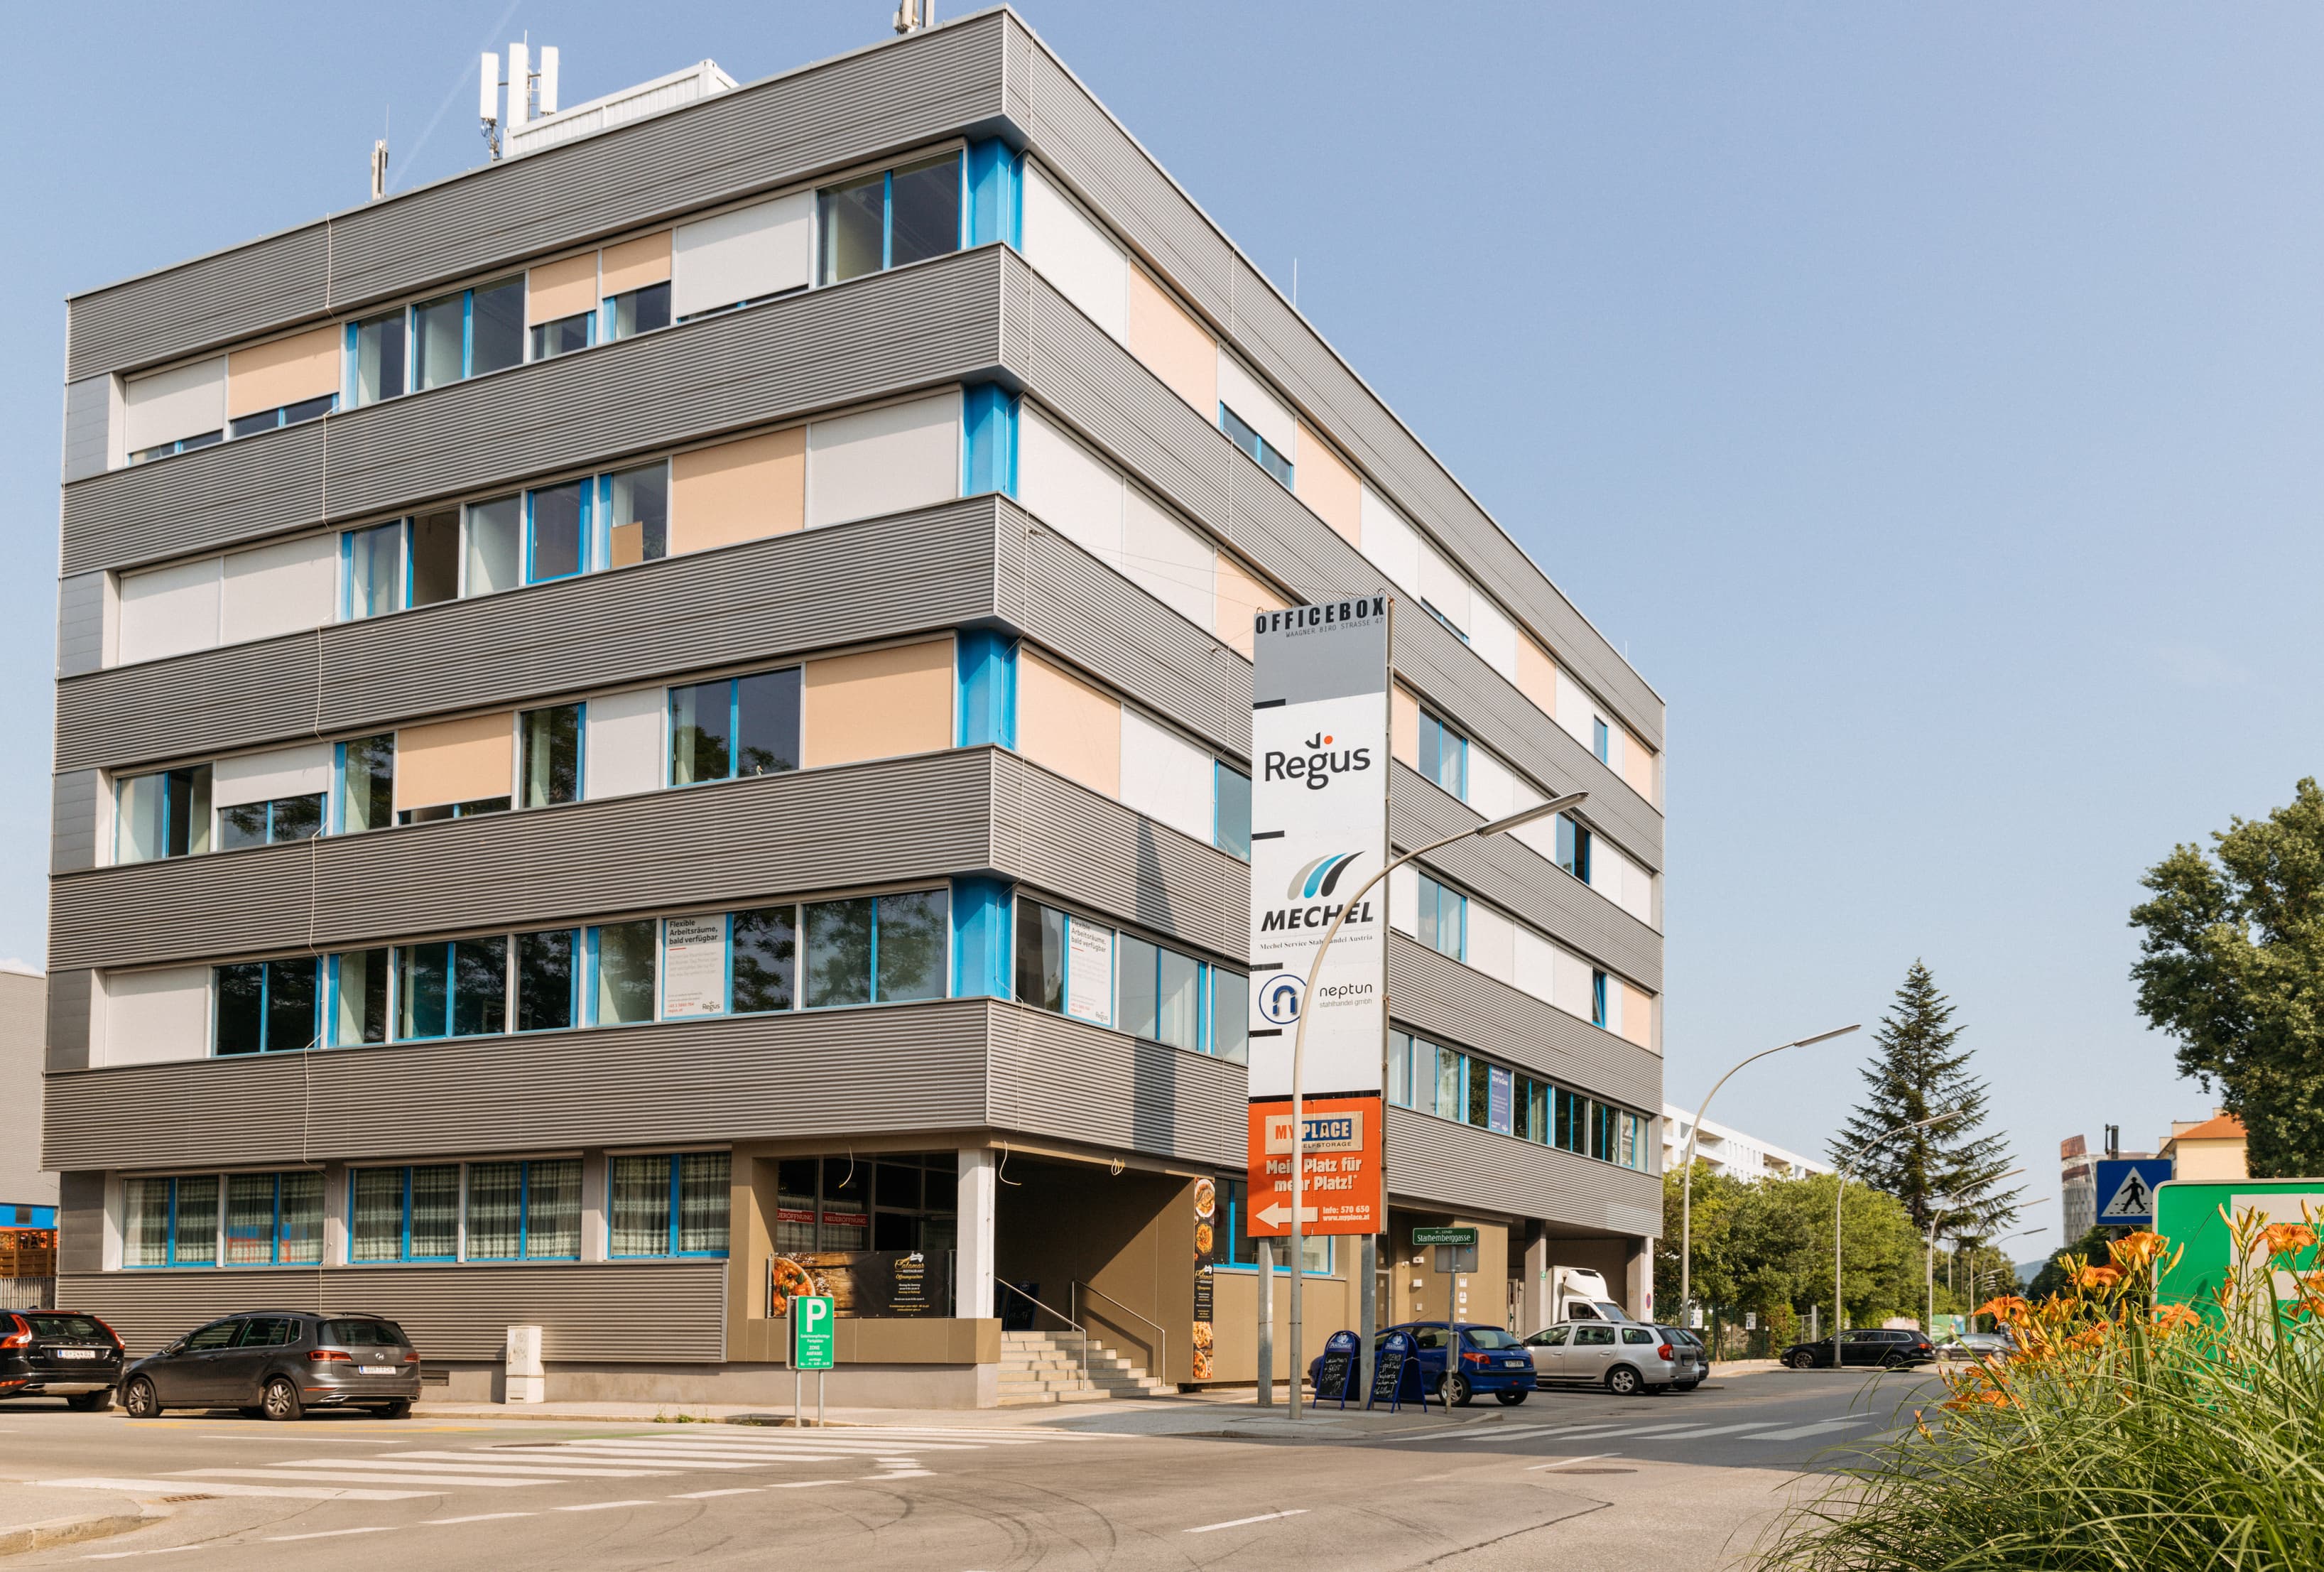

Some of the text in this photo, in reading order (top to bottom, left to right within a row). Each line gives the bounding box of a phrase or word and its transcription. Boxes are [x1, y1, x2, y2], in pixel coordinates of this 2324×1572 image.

[1256, 597, 1384, 634] OFFICEBOX
[1286, 628, 1315, 637] WAAGNER
[1320, 624, 1337, 633] BIRO
[1340, 619, 1370, 630] STRASSE
[1265, 748, 1370, 790] Regus
[669, 919, 695, 928] Flexible
[1261, 901, 1374, 932] MECHEL
[669, 926, 718, 936] Arbeitsräume,
[669, 934, 717, 945] bald verfügbar
[1071, 936, 1106, 953] bald verfügbar
[1308, 937, 1347, 945] Stahandel
[1320, 983, 1372, 999] neptun
[1319, 999, 1353, 1008] stahlhandel
[1266, 1156, 1362, 1175] Mei Platz für
[1356, 1205, 1370, 1213] 650
[1417, 1235, 1471, 1243] Starhemberggasse
[806, 1299, 827, 1333] P
